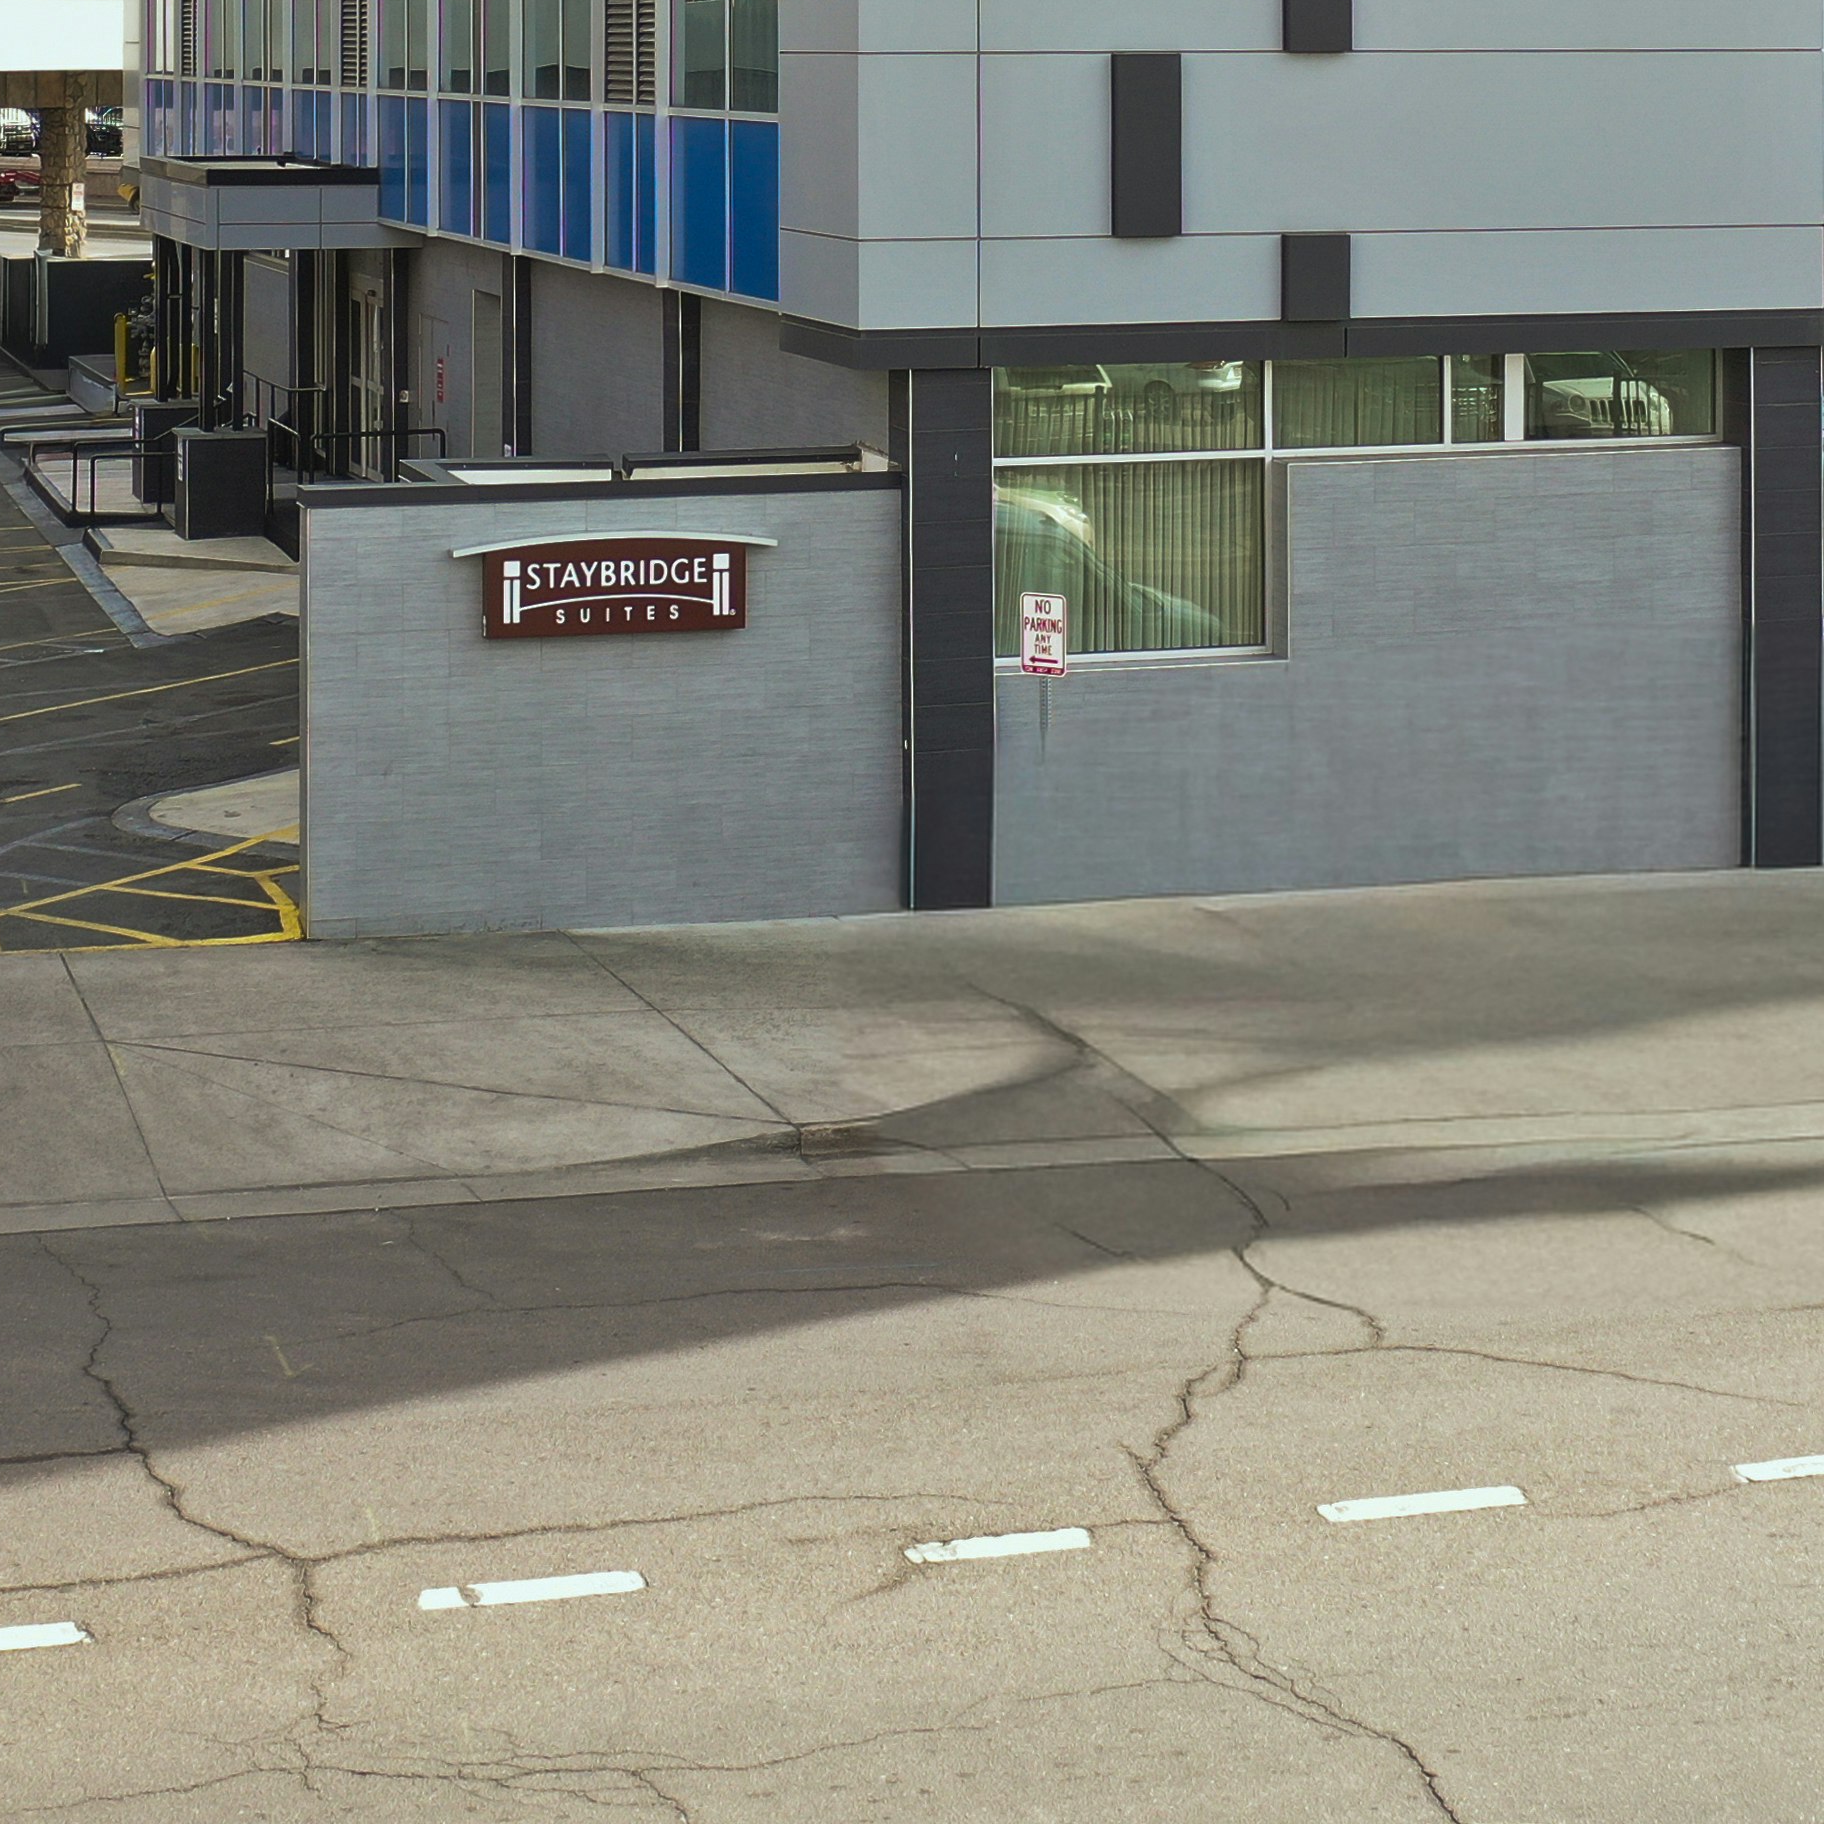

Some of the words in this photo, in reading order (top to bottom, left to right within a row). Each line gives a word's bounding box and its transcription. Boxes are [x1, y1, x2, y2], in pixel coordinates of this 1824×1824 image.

[526, 558, 707, 589] STAYBRIDGE
[556, 605, 679, 624] SUITES
[1035, 600, 1051, 614] NO
[1024, 616, 1063, 634] PARKING
[1035, 633, 1051, 644] ANY
[1034, 644, 1053, 656] TIME
